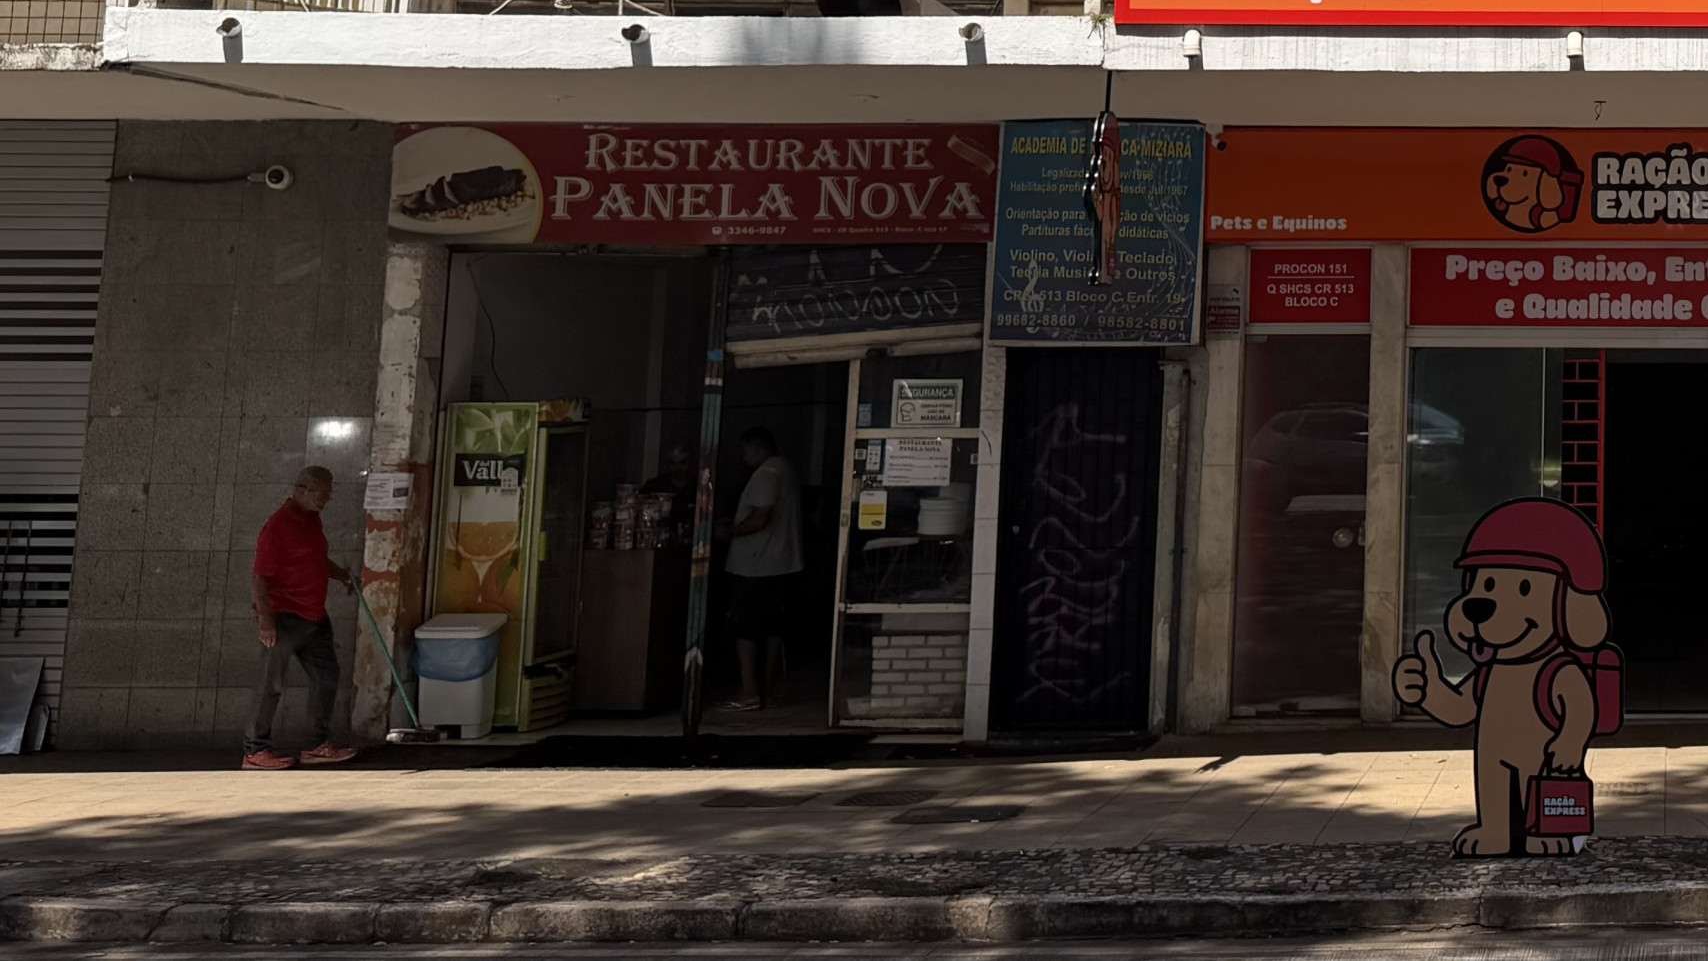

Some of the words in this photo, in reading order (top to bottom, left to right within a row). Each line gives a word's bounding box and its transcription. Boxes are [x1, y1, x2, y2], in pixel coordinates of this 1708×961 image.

[584, 132, 934, 173] RESTAURANTE
[1010, 135, 1067, 156] ACADEMIA
[1071, 137, 1086, 155] DE
[549, 175, 798, 222] PANELA
[814, 174, 984, 222] NOVA
[1005, 207, 1058, 222] Orientação
[1210, 214, 1251, 230] Pets
[1272, 214, 1348, 233] Equinos
[1274, 263, 1325, 274] PROCON
[1329, 263, 1347, 274] 151
[1445, 255, 1545, 285] Preço
[1553, 254, 1657, 285] Baixo,
[1280, 284, 1312, 294] SHCS
[1314, 284, 1331, 294] CR
[1334, 284, 1354, 294] 513
[1284, 296, 1327, 307] BLOCO
[1524, 292, 1692, 320] Qualidade
